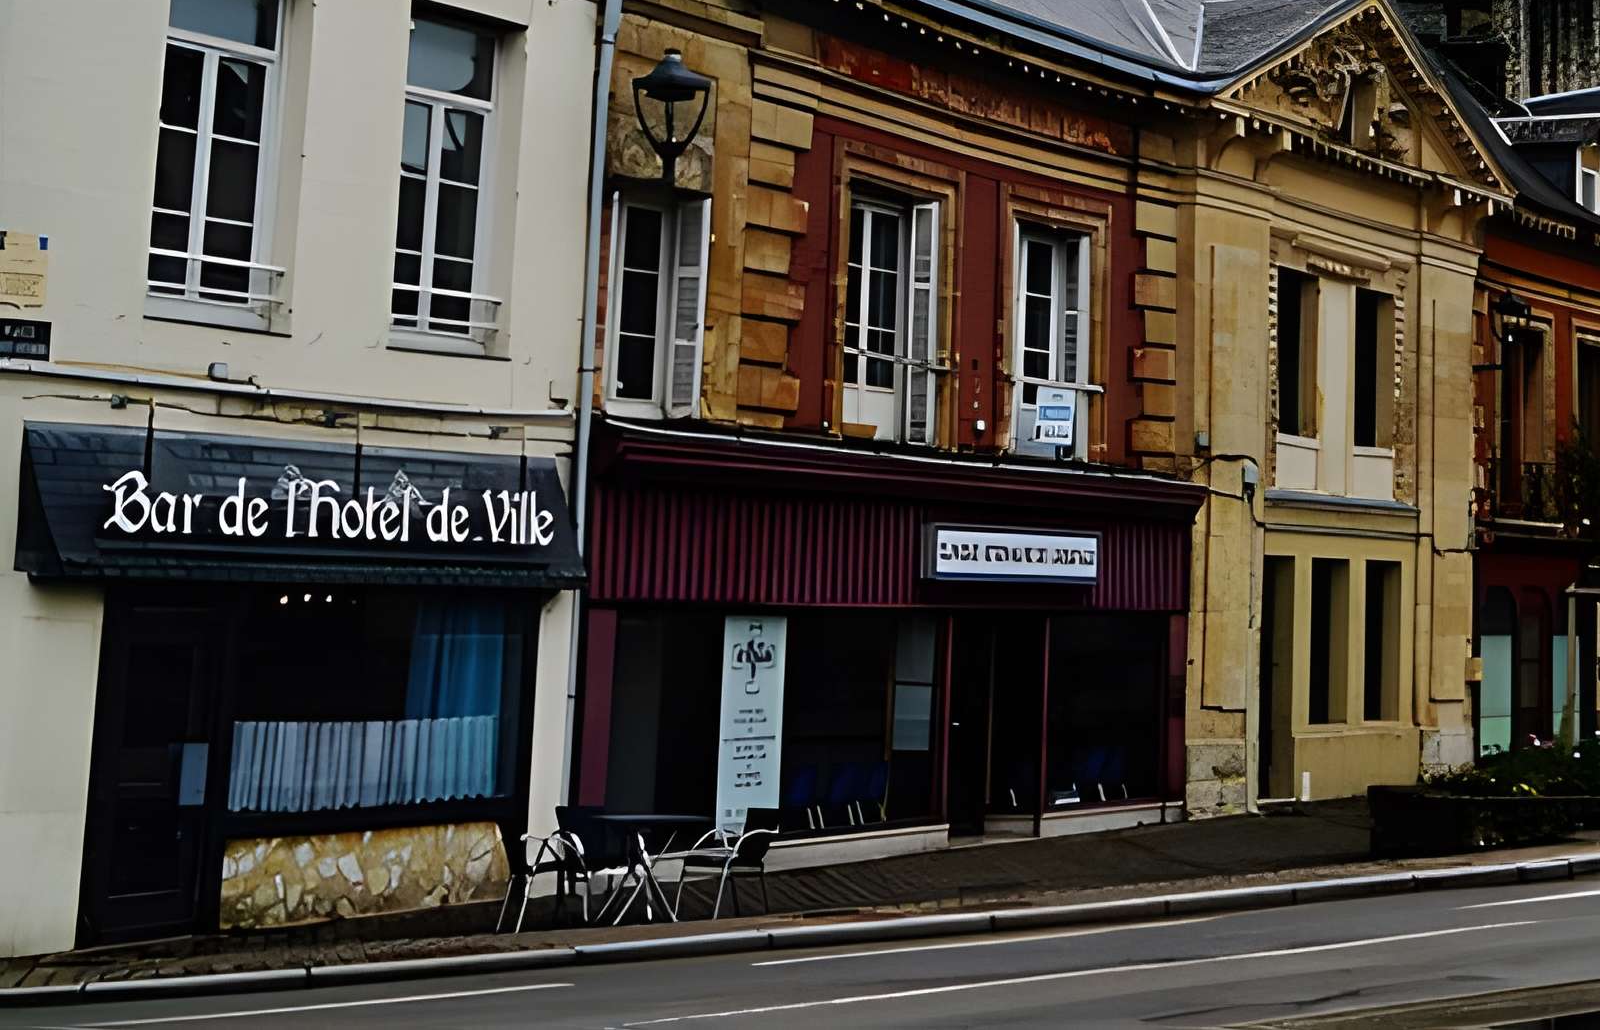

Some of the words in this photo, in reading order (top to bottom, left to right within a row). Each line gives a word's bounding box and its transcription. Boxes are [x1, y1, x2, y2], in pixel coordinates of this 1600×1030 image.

[103, 470, 202, 534] Bar
[219, 477, 269, 537] de
[426, 486, 469, 543] de
[482, 489, 554, 546] Ville
